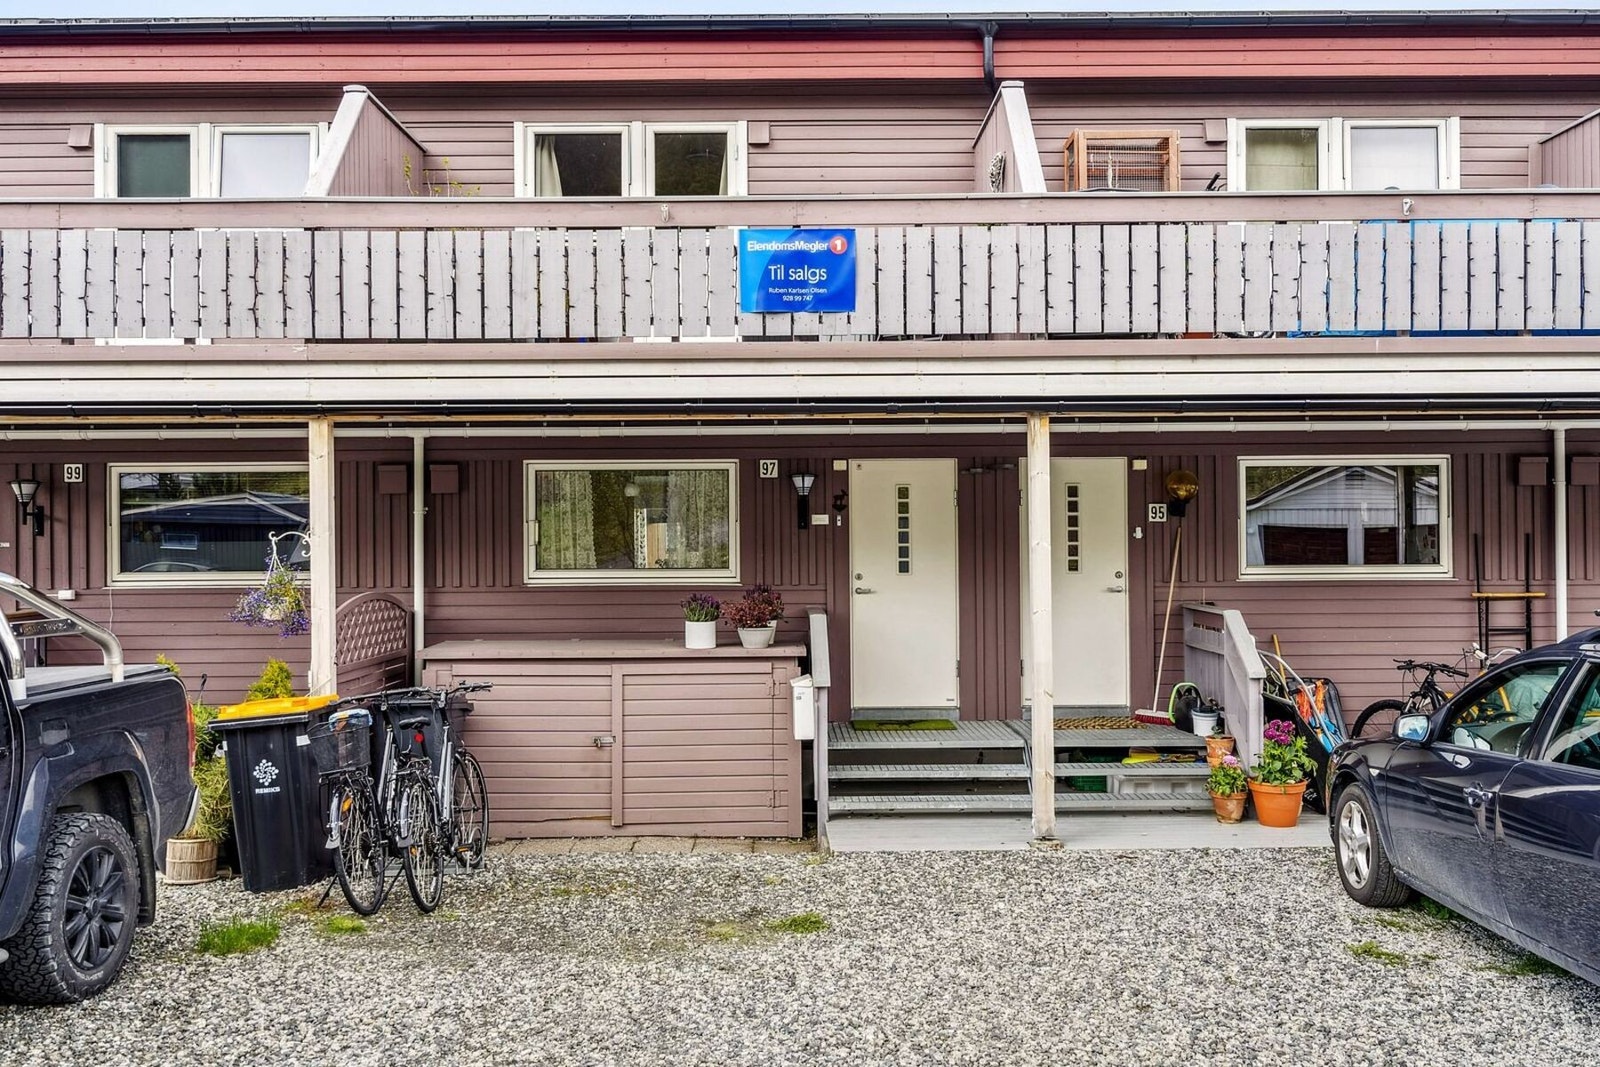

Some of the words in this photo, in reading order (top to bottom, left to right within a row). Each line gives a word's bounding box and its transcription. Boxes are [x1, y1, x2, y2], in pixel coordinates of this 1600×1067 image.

[747, 240, 828, 253] EiendomsMegler
[834, 239, 842, 251] 1
[768, 265, 785, 280] Til
[788, 265, 827, 284] salgs
[66, 466, 81, 480] 99
[761, 461, 776, 476] 97
[1150, 505, 1165, 520] 95
